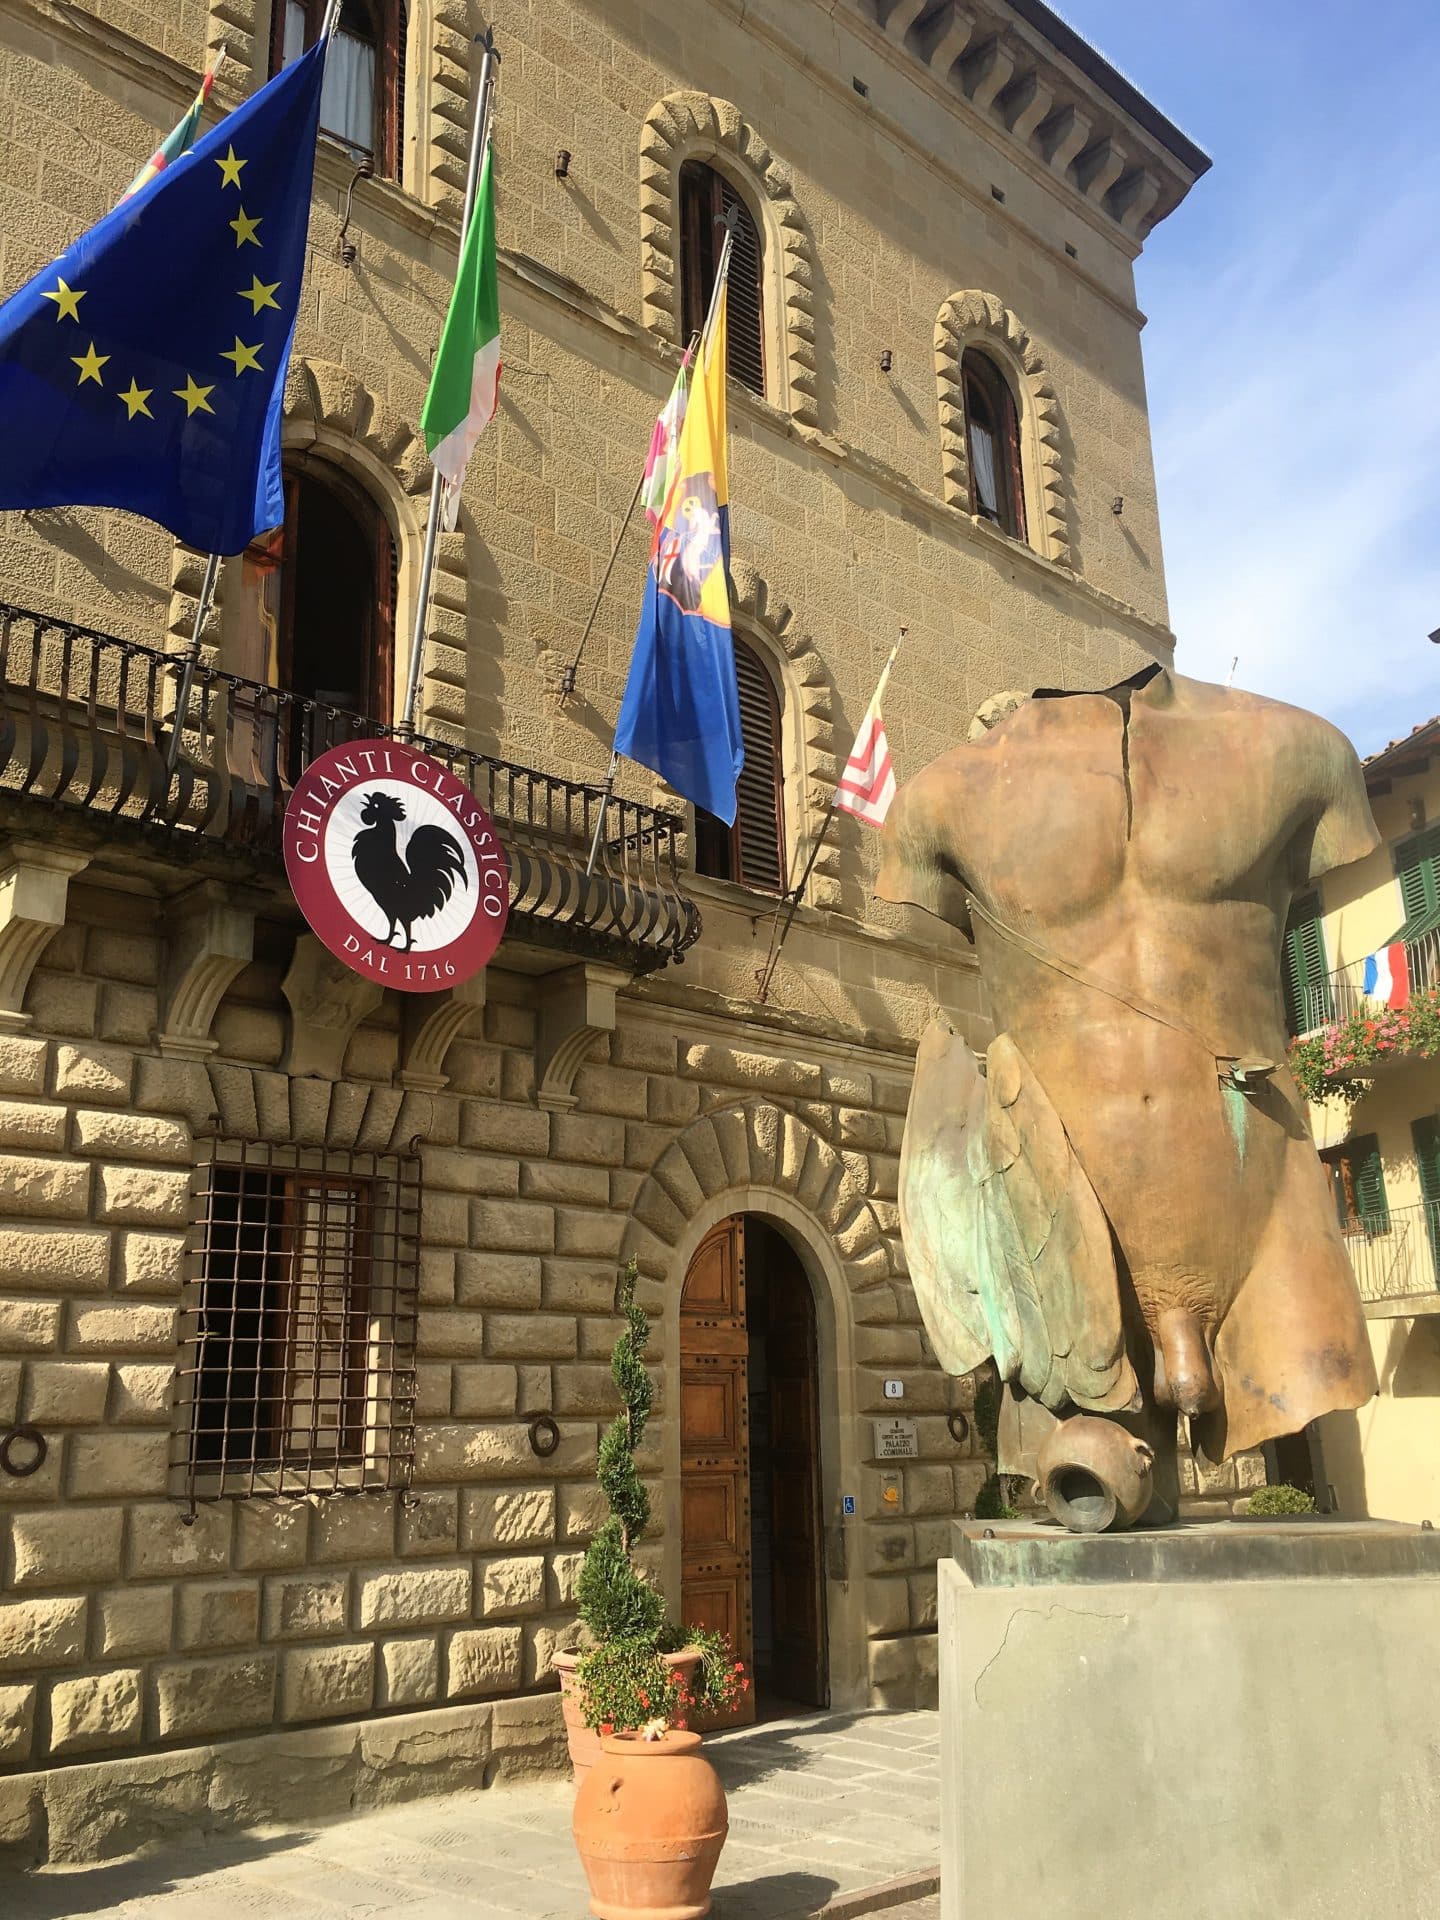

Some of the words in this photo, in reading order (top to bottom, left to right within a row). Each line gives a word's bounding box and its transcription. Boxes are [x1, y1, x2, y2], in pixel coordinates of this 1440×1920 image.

[296, 750, 394, 863] CHIANTI
[410, 761, 503, 917] CLASSICO
[342, 934, 389, 973] DAL
[404, 960, 456, 980] 1716
[891, 1383, 897, 1394] 8
[885, 1440, 910, 1448] PALAZZO
